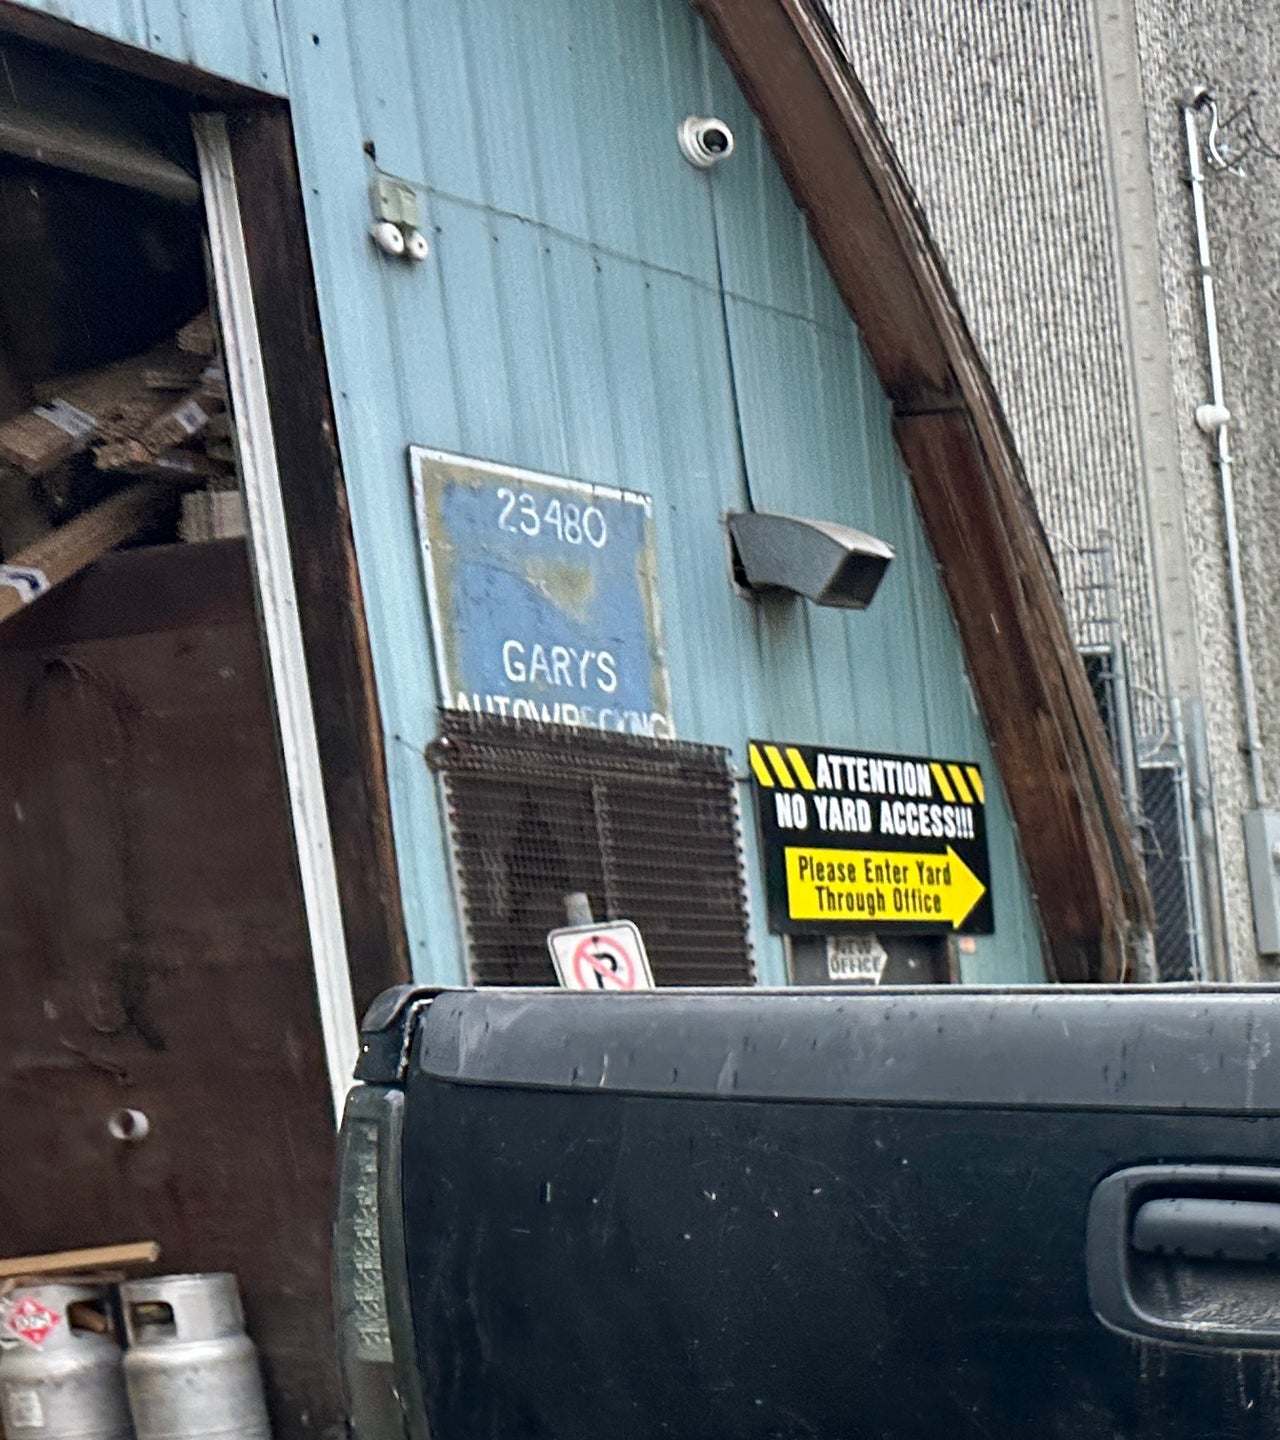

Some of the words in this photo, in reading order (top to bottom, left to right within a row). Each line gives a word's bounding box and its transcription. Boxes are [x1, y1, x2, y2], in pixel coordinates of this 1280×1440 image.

[497, 487, 608, 549] 23480
[816, 753, 933, 798] ATTENTION
[774, 792, 808, 829] NO
[814, 796, 872, 833] YARD
[880, 800, 975, 839] ACCESS!!!
[798, 854, 857, 884] Please
[863, 857, 908, 885] Enter
[915, 860, 952, 887] Yard
[814, 884, 886, 917] Through
[892, 887, 942, 914] Office
